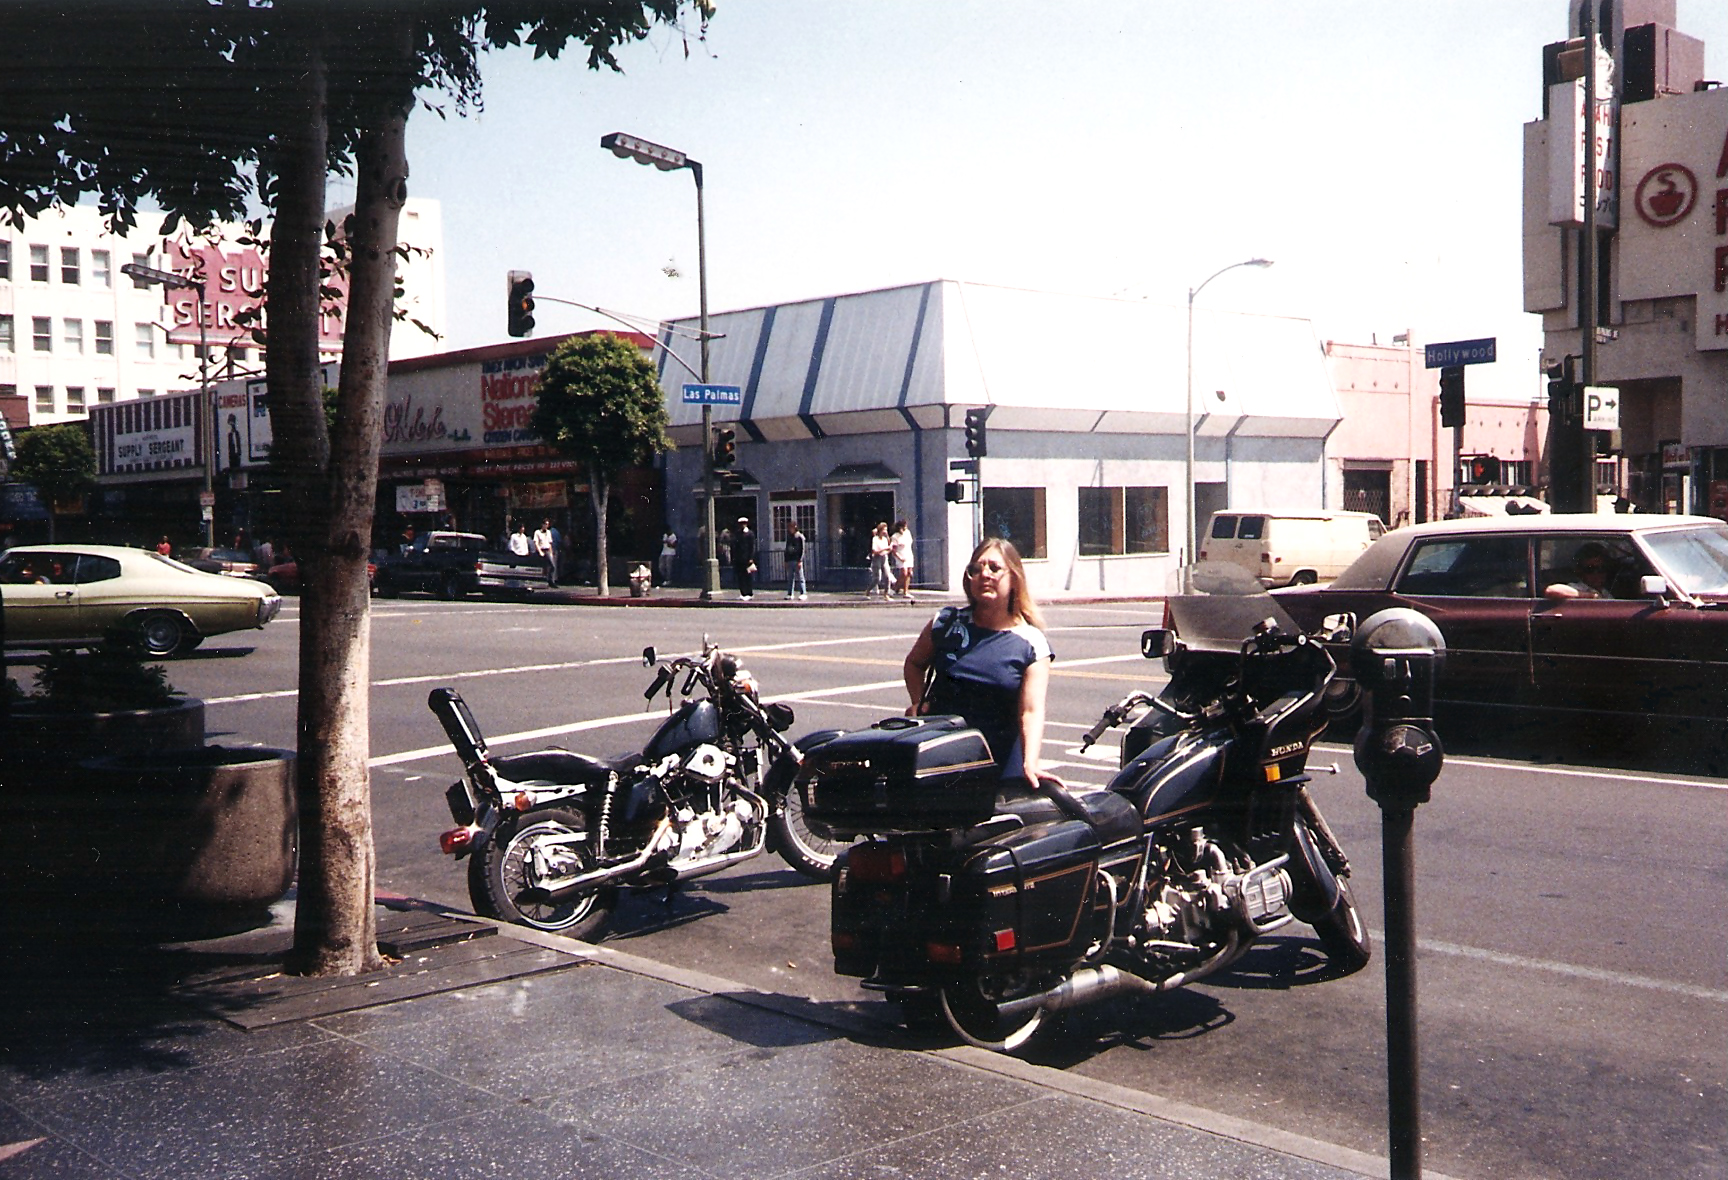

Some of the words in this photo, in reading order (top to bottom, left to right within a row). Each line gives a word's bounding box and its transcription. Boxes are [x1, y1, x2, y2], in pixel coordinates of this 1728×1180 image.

[1427, 343, 1494, 363] Hollywood
[683, 388, 700, 400] Las
[704, 389, 739, 401] Palmas
[118, 444, 142, 458] SUPPLY
[149, 438, 185, 455] SERGEANT
[1271, 741, 1304, 757] HONDA
